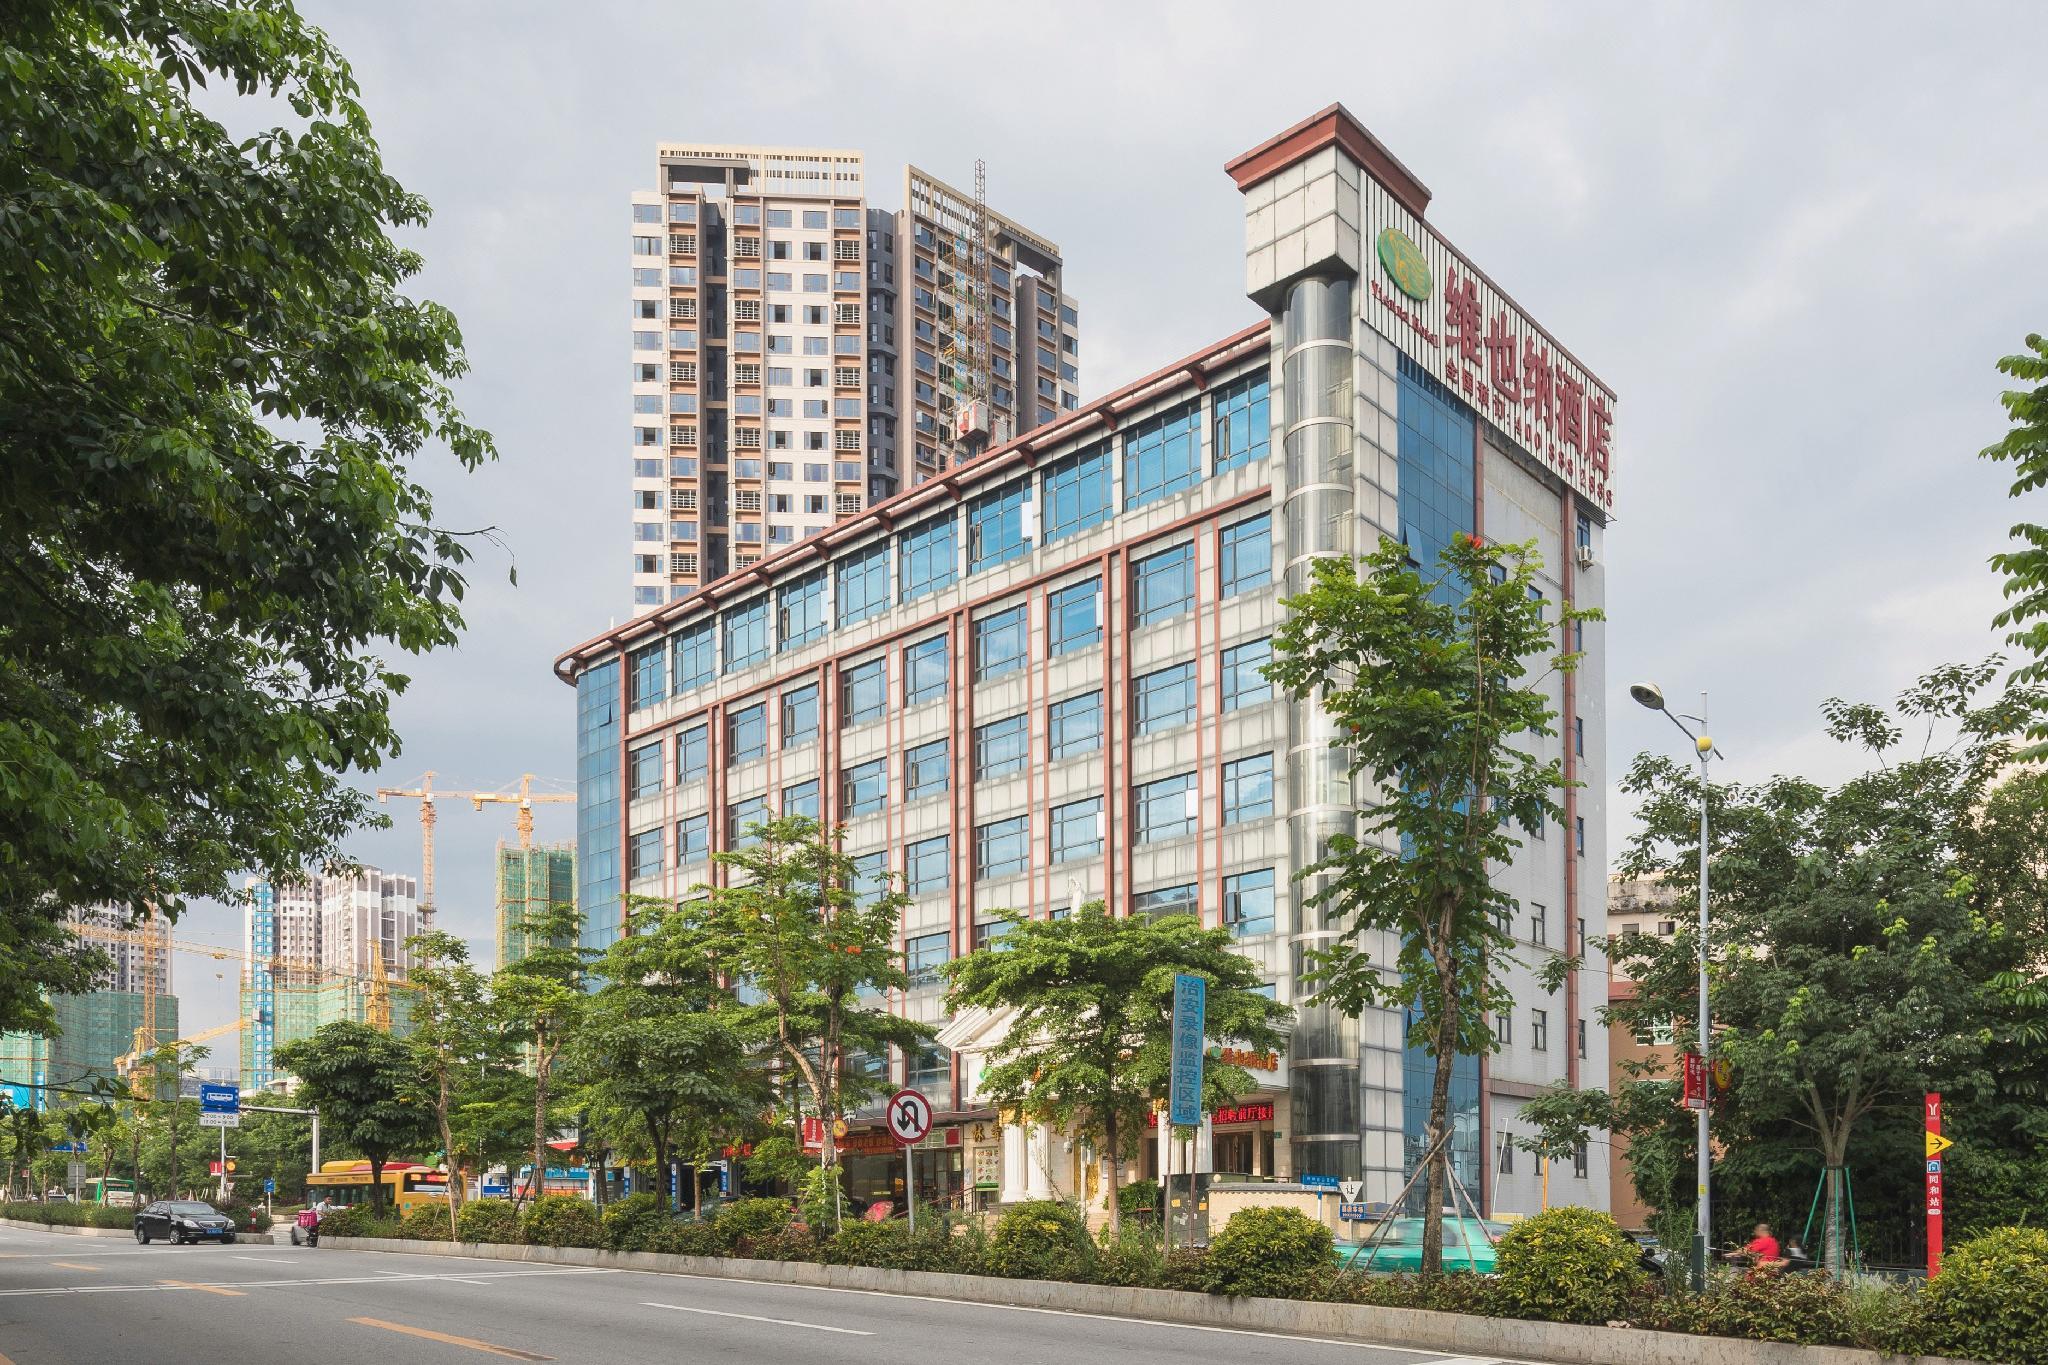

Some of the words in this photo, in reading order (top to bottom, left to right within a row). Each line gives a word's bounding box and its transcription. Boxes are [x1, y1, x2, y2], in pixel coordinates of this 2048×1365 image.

[1371, 280, 1409, 322] Vienna
[1411, 314, 1440, 348] Hotel
[1444, 266, 1614, 481] 维也纳酒店
[1176, 979, 1200, 1121] 治安录像监控区域
[1345, 1184, 1354, 1195] 让
[1929, 1174, 1940, 1207] 同和站
